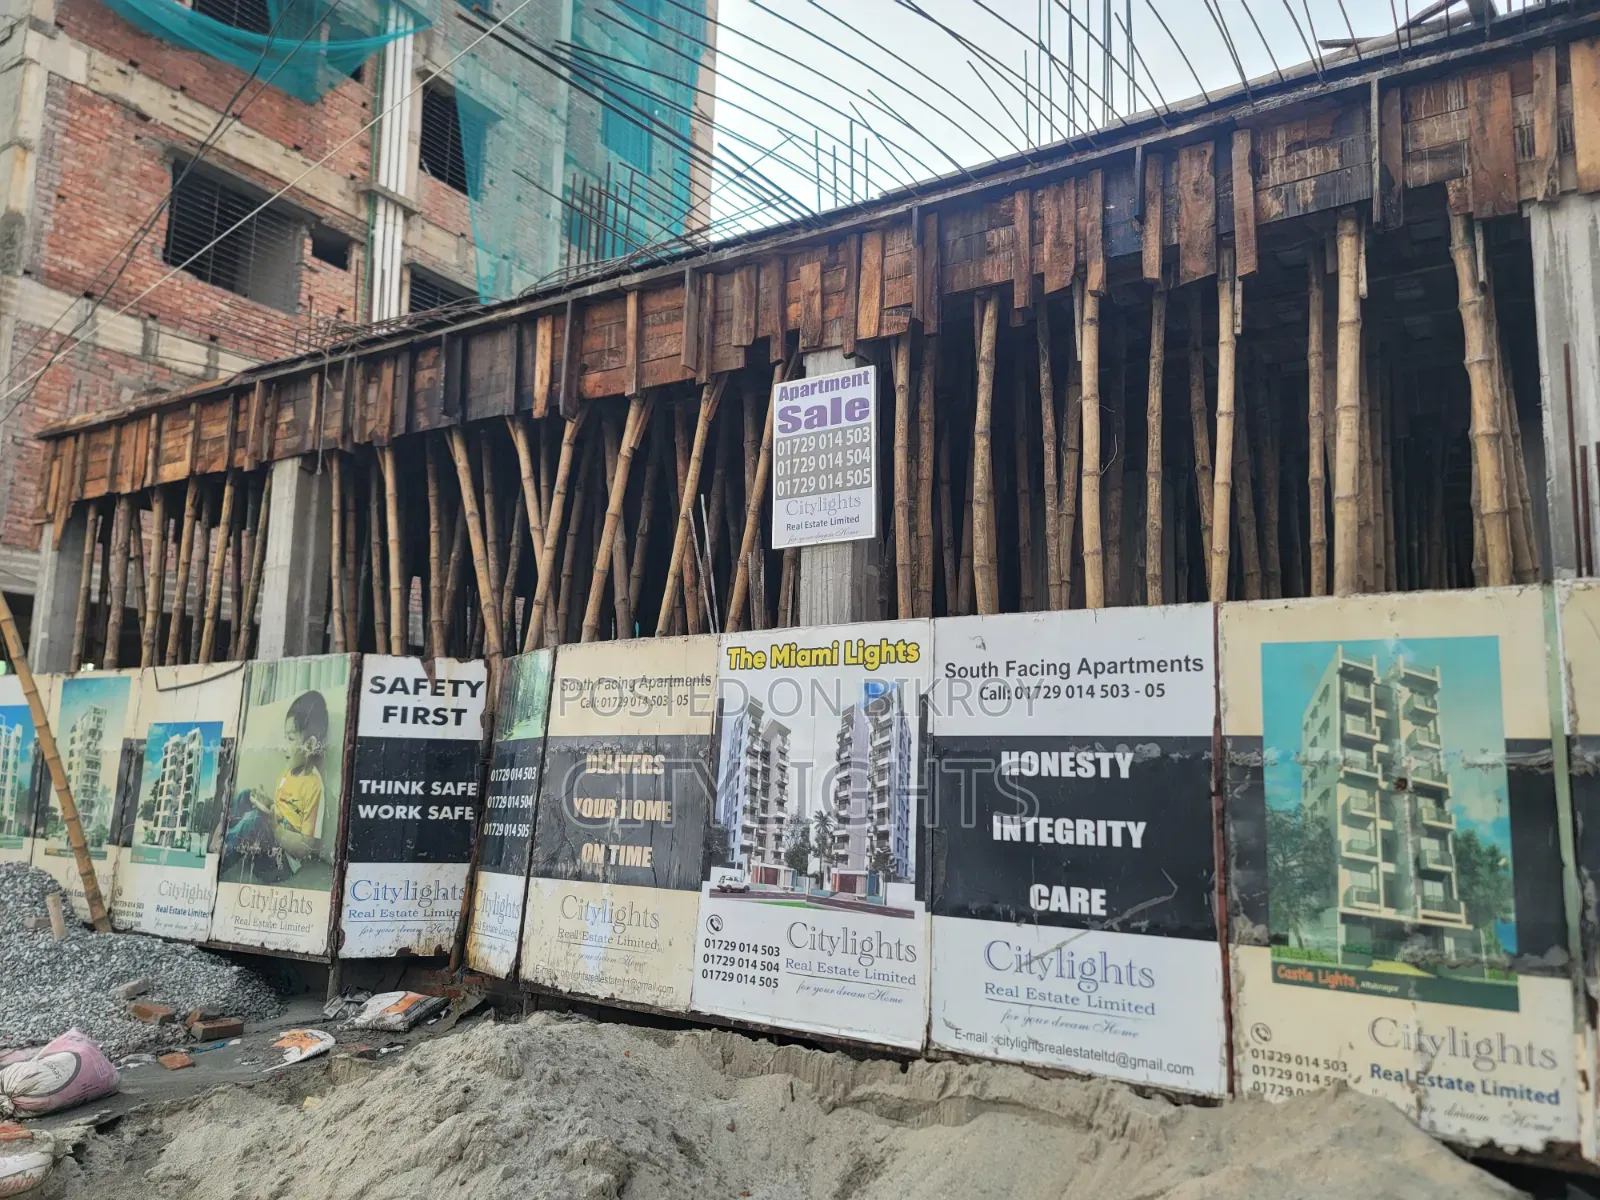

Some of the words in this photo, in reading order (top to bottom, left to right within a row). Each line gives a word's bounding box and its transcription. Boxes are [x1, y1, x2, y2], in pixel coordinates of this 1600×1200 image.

[779, 370, 870, 401] Apartment
[778, 397, 870, 434] Sale
[777, 435, 815, 456] 01729
[819, 430, 843, 450] 014
[846, 426, 870, 445] 503
[777, 456, 816, 476] 01729
[819, 450, 843, 470] 014
[846, 447, 871, 466] 504
[777, 476, 816, 496] 01729
[819, 471, 843, 490] 014
[846, 468, 871, 487] 505
[785, 494, 861, 516] Citylights
[786, 521, 803, 531] Real
[804, 519, 828, 529] Estate
[830, 514, 860, 526] Limited
[727, 647, 766, 670] The
[769, 640, 839, 669] Miami
[843, 638, 920, 671] Lights
[945, 662, 999, 679] South
[1005, 659, 1071, 680] Facing
[1077, 655, 1205, 679] Apartments
[369, 676, 485, 698] SAFETY
[560, 678, 594, 691] South
[598, 676, 636, 692] Facing
[639, 673, 712, 692] Apartments
[979, 685, 1011, 700] Call:
[1014, 685, 1061, 699] 01729
[1066, 684, 1096, 698] 014
[1100, 683, 1130, 698] 503
[1145, 683, 1166, 697] 05
[580, 697, 599, 709] Call:
[601, 696, 628, 708] 01729
[631, 696, 648, 707] 014
[651, 695, 668, 706] 503
[677, 694, 689, 706] 05
[382, 705, 467, 726] FIRST
[490, 768, 510, 781] 01729
[511, 767, 523, 780] 014
[523, 766, 537, 780] 503
[586, 754, 665, 775] DELIVERS
[1000, 751, 1135, 778] HONESTY
[359, 780, 425, 795] THINK
[430, 781, 478, 796] SAFE
[358, 804, 422, 819] WORK
[427, 806, 475, 820] SAFE
[487, 796, 507, 808] 01729
[507, 795, 520, 808] 014
[520, 795, 533, 808] 504
[573, 798, 617, 818] YOUR
[620, 799, 672, 821] HOME
[484, 823, 504, 835] 01729
[504, 823, 517, 836] 014
[517, 824, 530, 837] 505
[992, 815, 1147, 848] INTEGRITY
[581, 843, 605, 866] ON
[609, 845, 653, 868] TIME
[159, 880, 213, 904] Citylights
[238, 886, 313, 920] Citylights
[350, 880, 466, 908] Citylights
[1029, 884, 1107, 916] CARE
[156, 904, 168, 914] Real
[169, 905, 187, 916] Estate
[188, 908, 210, 919] Limited
[348, 909, 375, 918] Real
[380, 909, 419, 918] Estate
[423, 909, 461, 919] Limite
[474, 889, 520, 924] Citylights
[560, 895, 660, 934] Citylights
[234, 916, 251, 926] Real
[253, 917, 277, 929] Estate
[280, 921, 311, 933] Limited
[557, 927, 579, 940] Real
[582, 931, 613, 944] Estate
[617, 935, 658, 950] Limited
[704, 938, 736, 951] 01729
[738, 943, 758, 955] 014
[761, 945, 780, 957] 503
[786, 921, 917, 966] Citylights
[703, 953, 735, 966] 01729
[738, 957, 757, 969] 014
[759, 961, 780, 973] 504
[785, 958, 812, 972] Real
[817, 962, 860, 977] Estate
[865, 968, 916, 985] Limited
[984, 940, 1155, 993] Citylights
[701, 968, 734, 982] 01729
[736, 973, 756, 985] 014
[758, 976, 779, 989] 505
[1277, 965, 1314, 983] Castle
[1317, 969, 1360, 991] Lights,
[796, 980, 811, 994] for
[813, 985, 836, 996] your
[836, 985, 865, 999] dream
[868, 988, 903, 1004] Home
[984, 982, 1020, 998] Real
[1026, 987, 1080, 1006] Estate
[1087, 995, 1156, 1016] Limited
[1001, 1008, 1019, 1023] for
[1022, 1013, 1050, 1027] your
[1051, 1014, 1090, 1031] dream
[1092, 1020, 1139, 1038] Home
[955, 1028, 988, 1044] E-mail
[996, 1034, 1195, 1077] citylightsrealestateltd@gmail.com
[1368, 1016, 1558, 1072] Citylights
[1252, 1064, 1293, 1080] 01729
[1296, 1070, 1321, 1085] 014
[1295, 1054, 1320, 1069] 014
[1323, 1059, 1348, 1073] 503
[1252, 1080, 1294, 1097] 01729
[1370, 1063, 1406, 1083] Real
[1415, 1070, 1475, 1094] Estate
[1480, 1079, 1560, 1106] Limited
